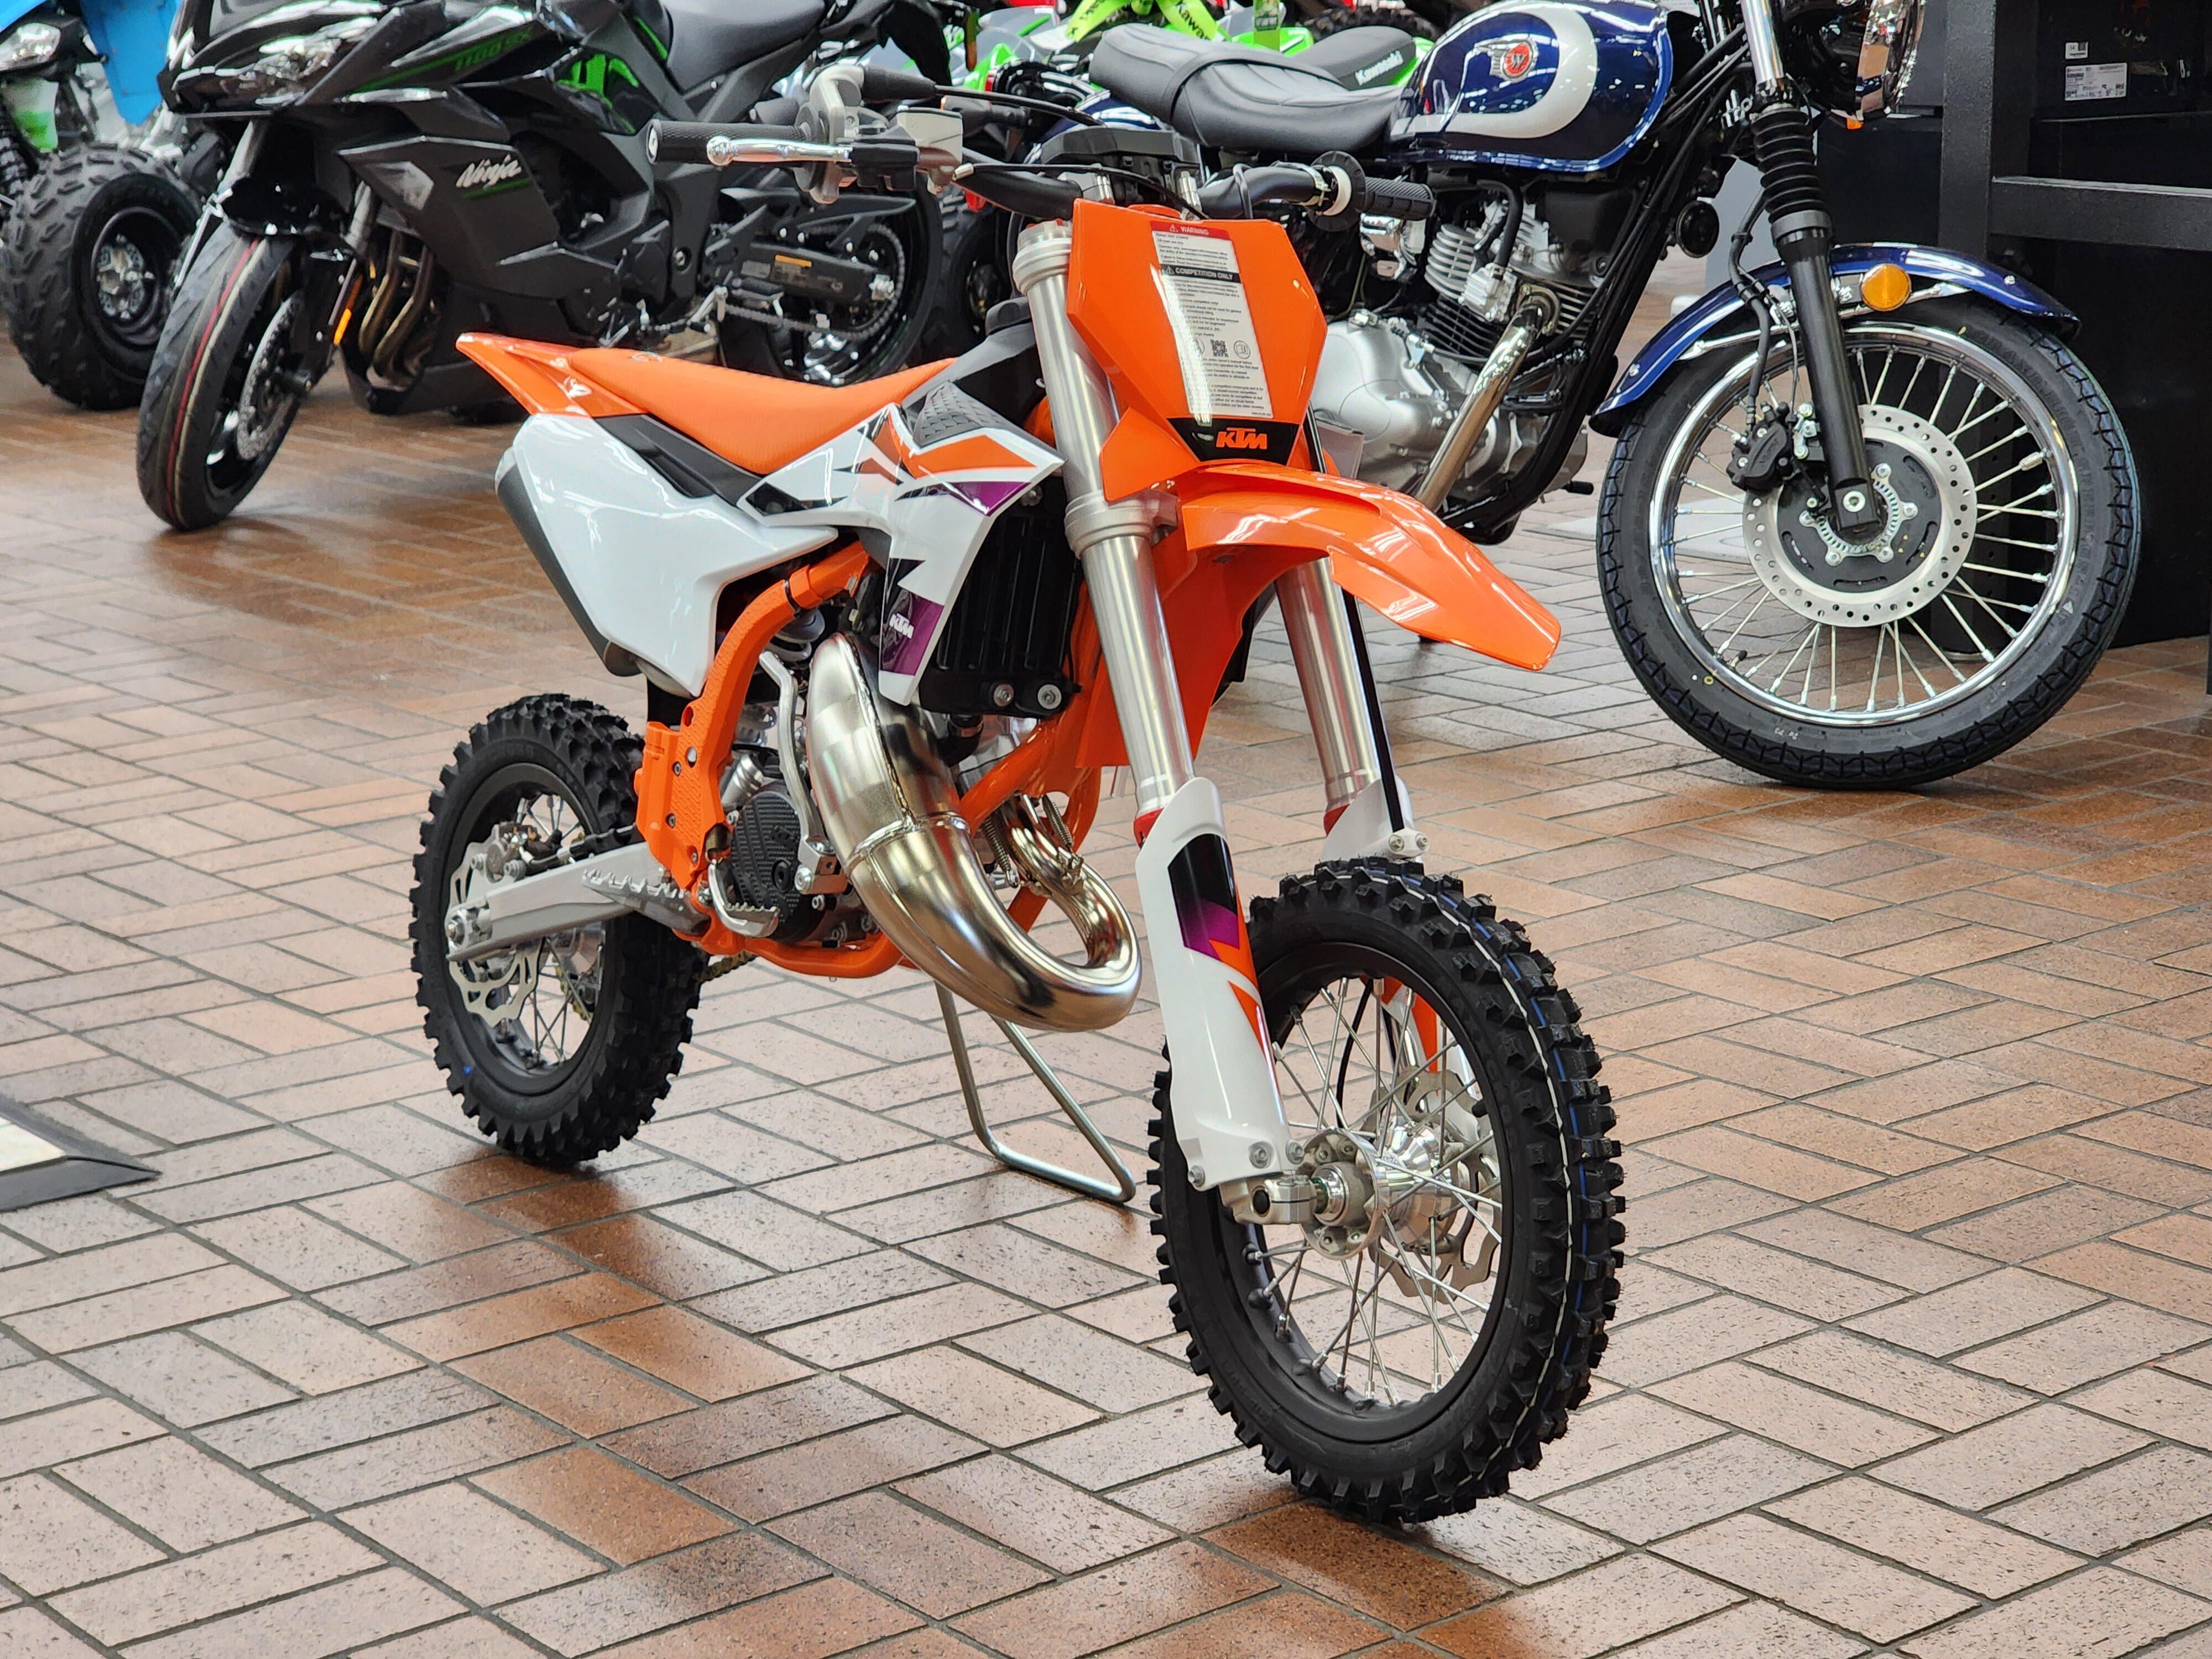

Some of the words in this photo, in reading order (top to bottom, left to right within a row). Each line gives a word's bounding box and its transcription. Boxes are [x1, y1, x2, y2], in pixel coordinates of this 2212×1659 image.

[1510, 53, 1527, 70] W
[456, 153, 522, 190] Ninja
[1181, 226, 1209, 235] WARNING
[1175, 268, 1217, 279] COMPETITION
[1216, 427, 1267, 450] KTM
[889, 612, 915, 639] KTM
